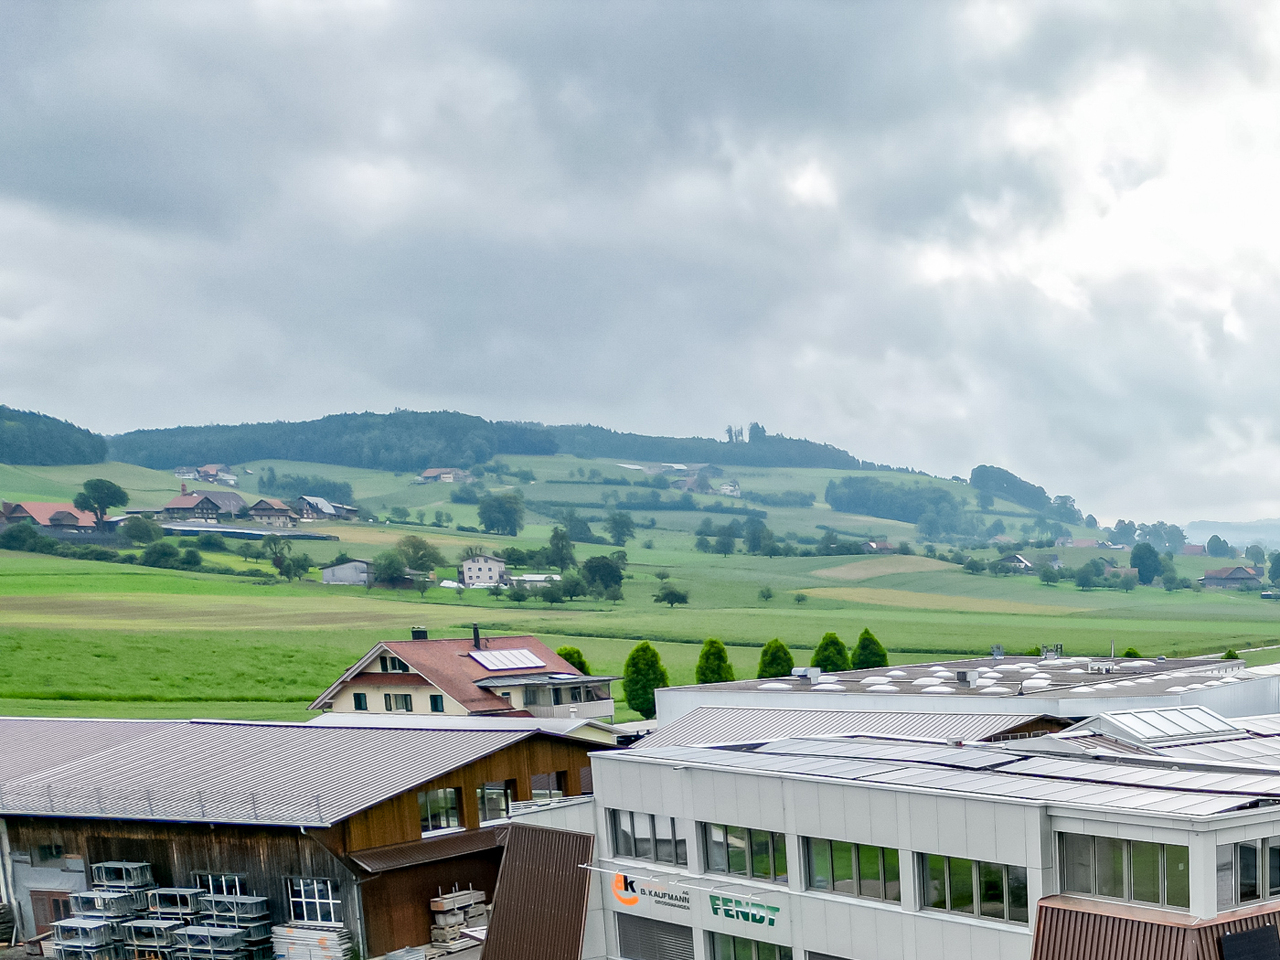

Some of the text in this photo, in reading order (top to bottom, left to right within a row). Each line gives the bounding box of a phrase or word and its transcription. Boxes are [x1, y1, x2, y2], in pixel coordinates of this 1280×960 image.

[640, 888, 690, 904] B. KAUFMANN
[709, 894, 780, 927] FENDT
